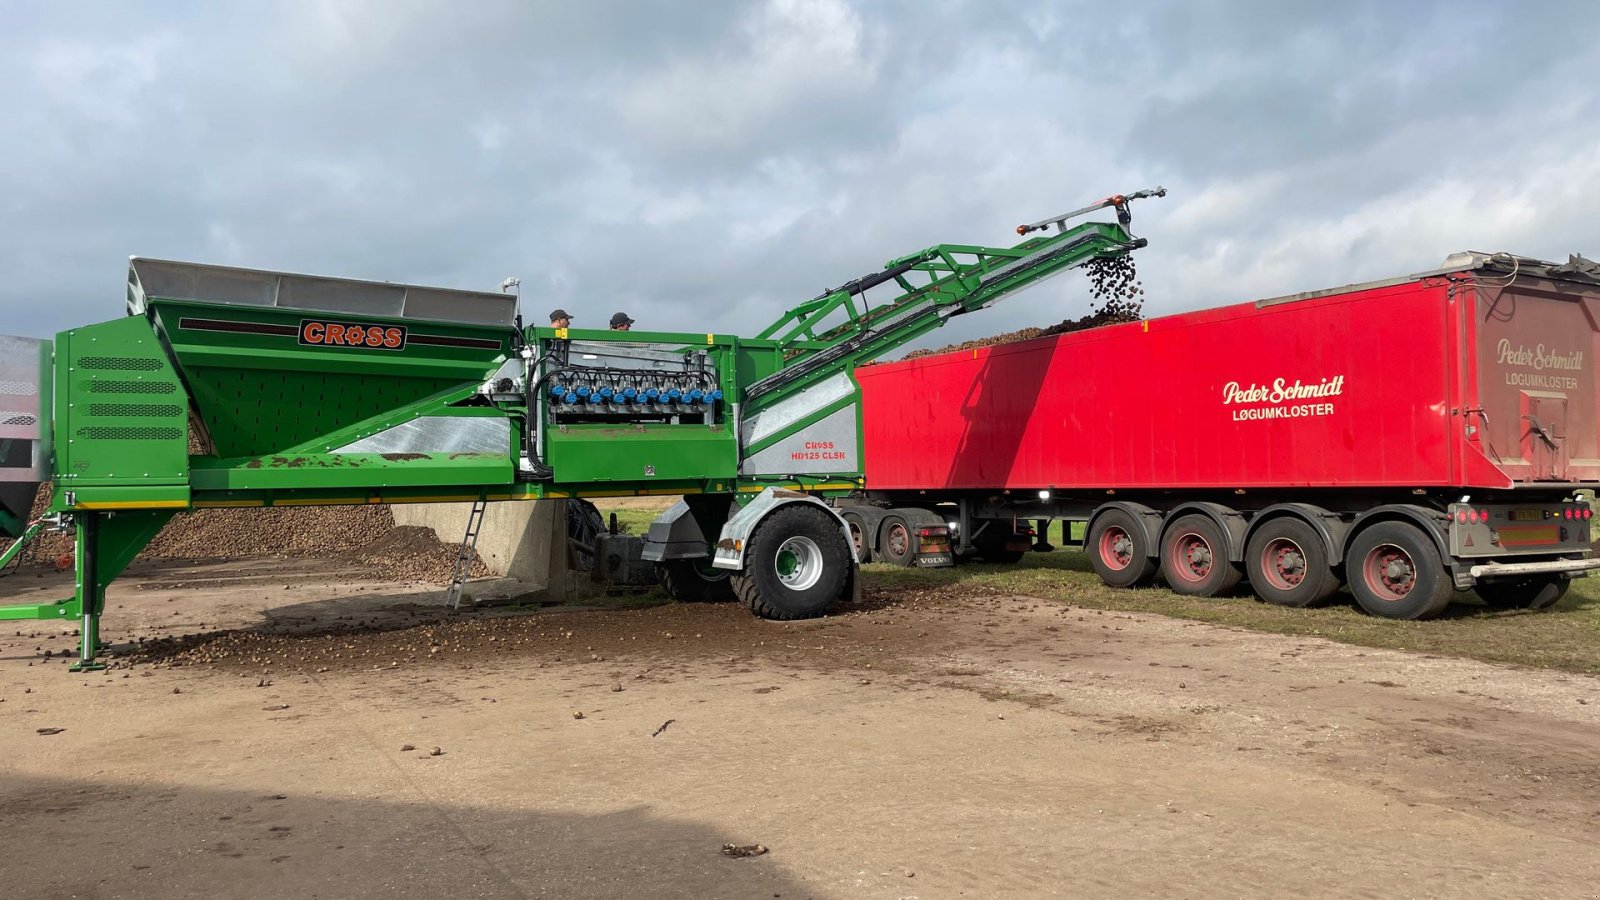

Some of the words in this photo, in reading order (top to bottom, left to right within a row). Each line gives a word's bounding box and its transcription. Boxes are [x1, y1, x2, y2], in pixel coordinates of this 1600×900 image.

[304, 322, 402, 348] CROSS
[1497, 338, 1534, 366] Peder
[1533, 343, 1583, 370] Schmidt
[1223, 381, 1270, 404] Peder
[1269, 375, 1344, 403] Schmidt
[1505, 372, 1577, 389] LØGUMKLOSTER
[1233, 403, 1334, 421] LØGUMKLOSTER
[805, 441, 834, 449] CROSS
